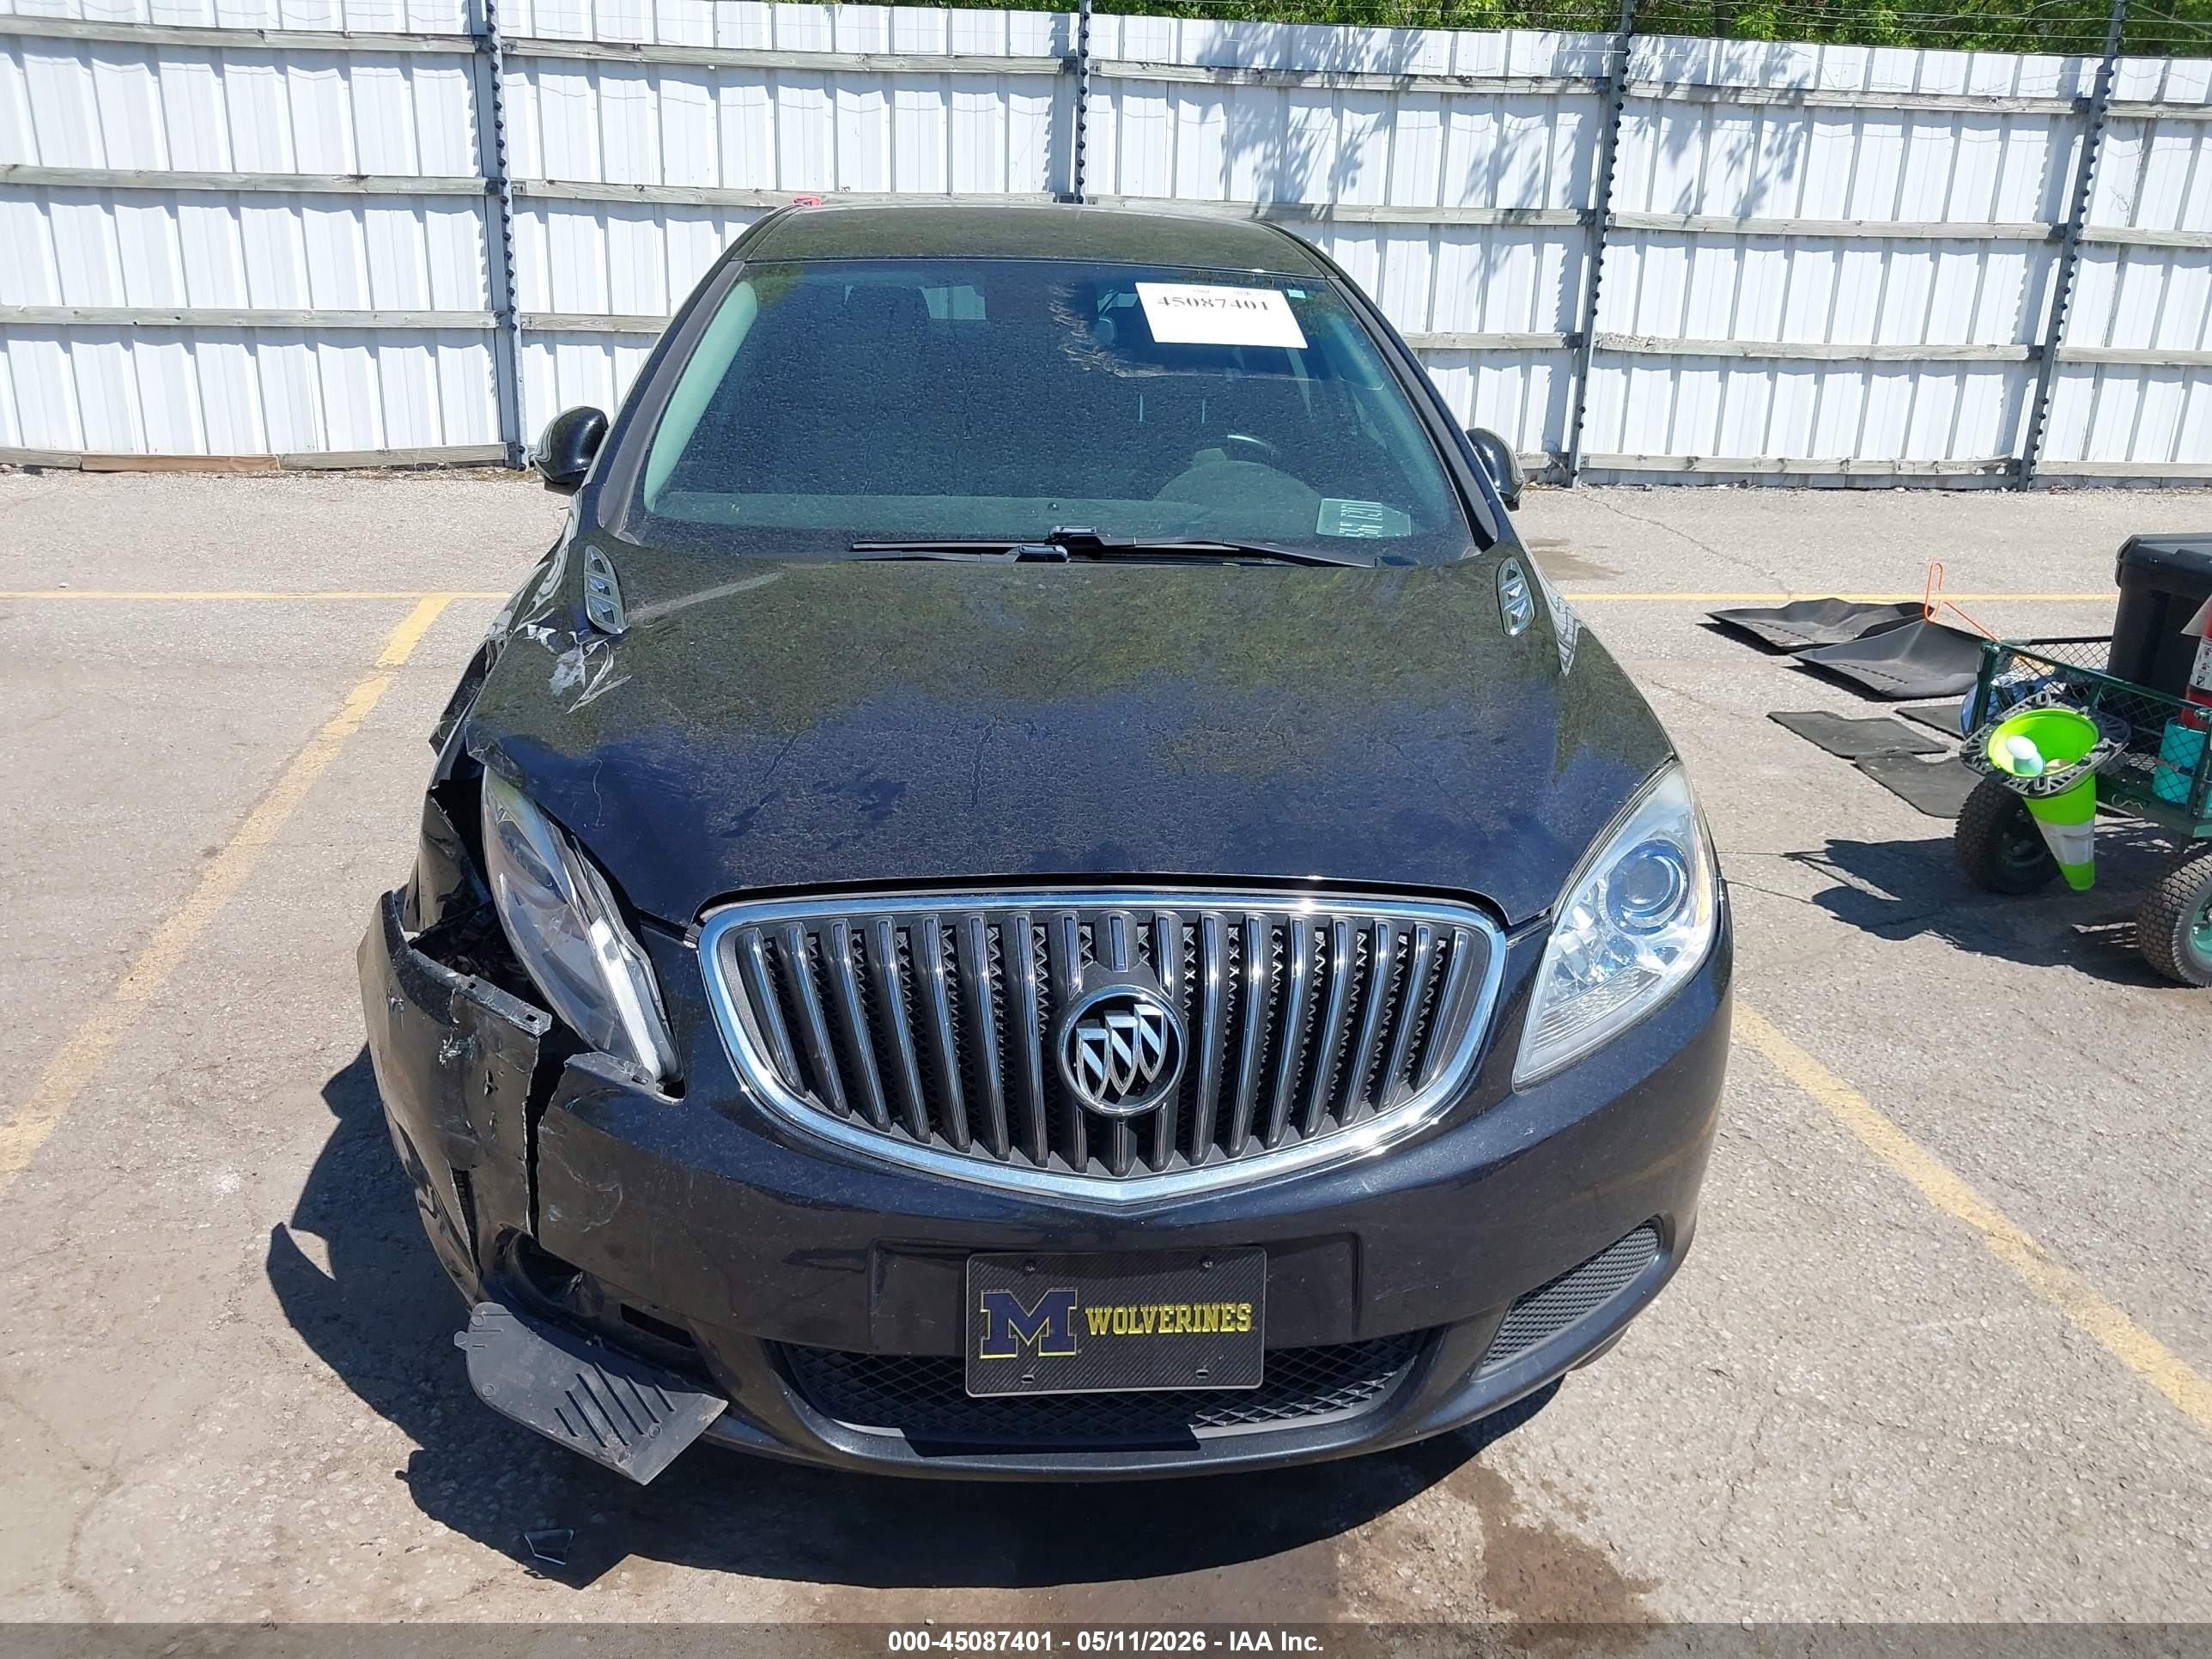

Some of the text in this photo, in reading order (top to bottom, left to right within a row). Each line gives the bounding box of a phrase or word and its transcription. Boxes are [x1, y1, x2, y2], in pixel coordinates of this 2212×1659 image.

[1158, 296, 1269, 311] 45087401
[980, 1287, 1252, 1359] M WOLVERINES
